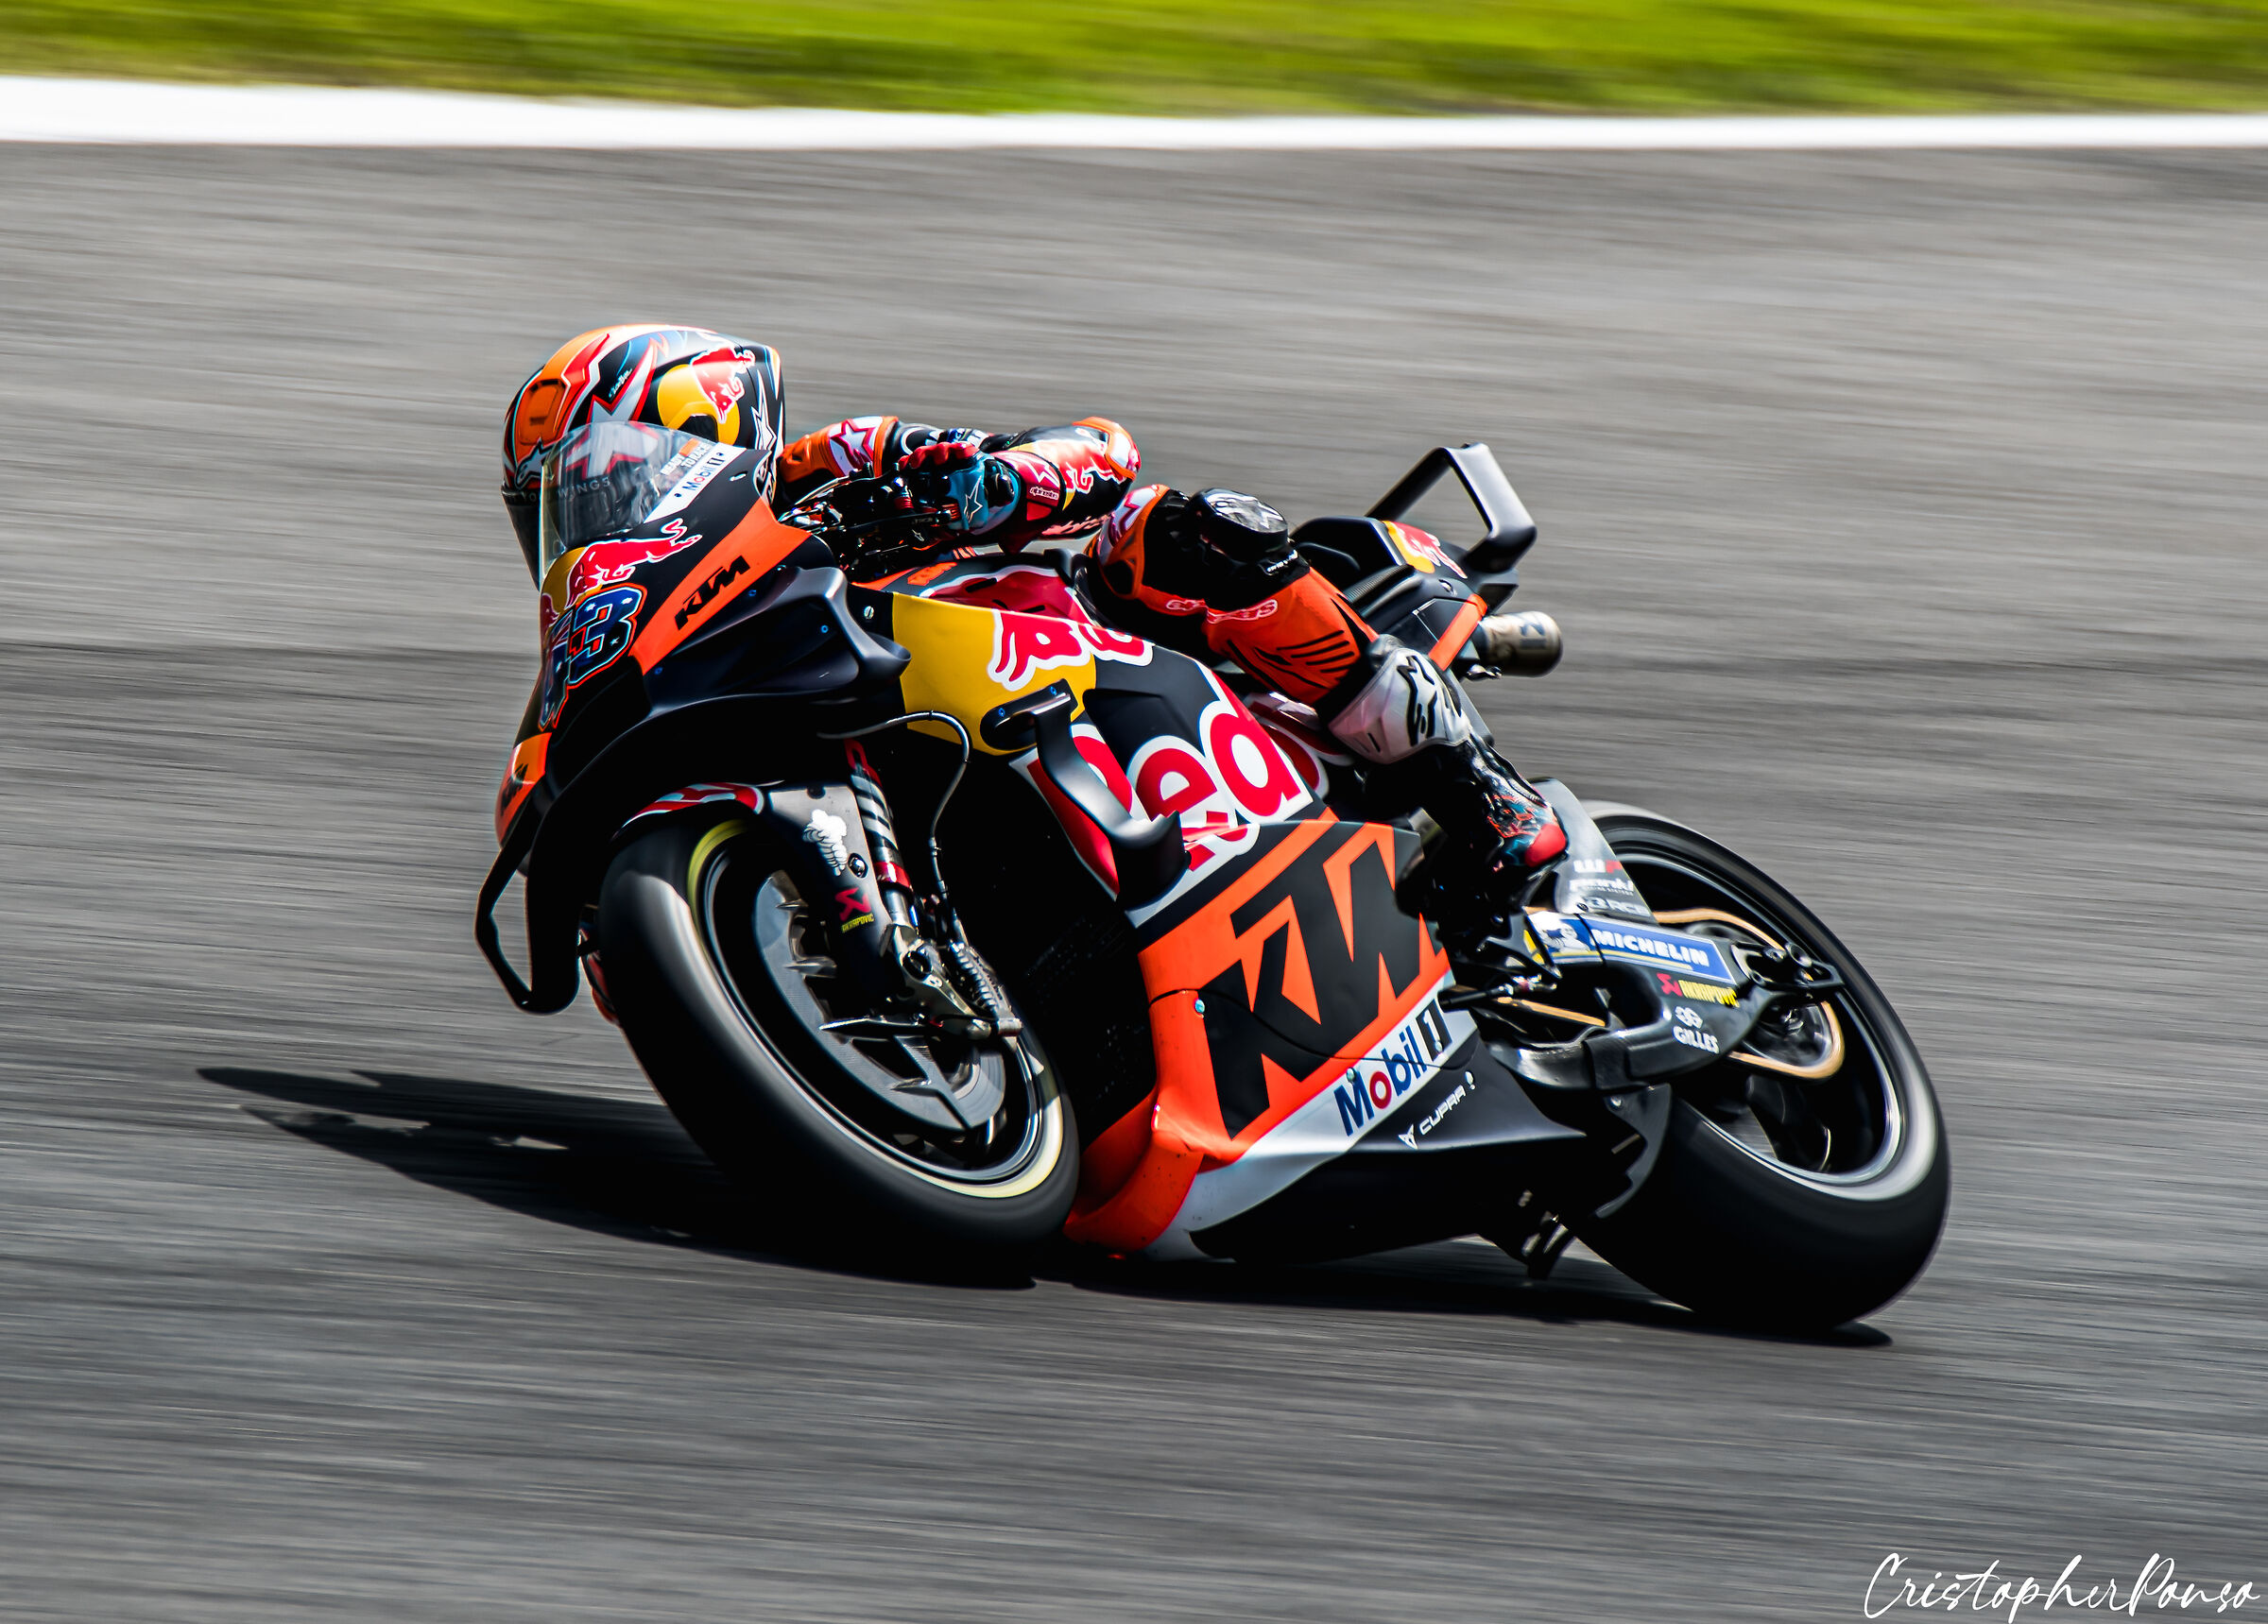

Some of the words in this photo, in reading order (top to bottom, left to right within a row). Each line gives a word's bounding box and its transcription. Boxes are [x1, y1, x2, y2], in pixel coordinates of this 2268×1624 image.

[681, 465, 717, 491] Mobil
[674, 555, 751, 631] KTM
[1198, 831, 1421, 1141] KTM
[1589, 929, 1710, 967] MICHELIN
[1333, 1025, 1427, 1137] Mobil
[1418, 1001, 1450, 1059] 1
